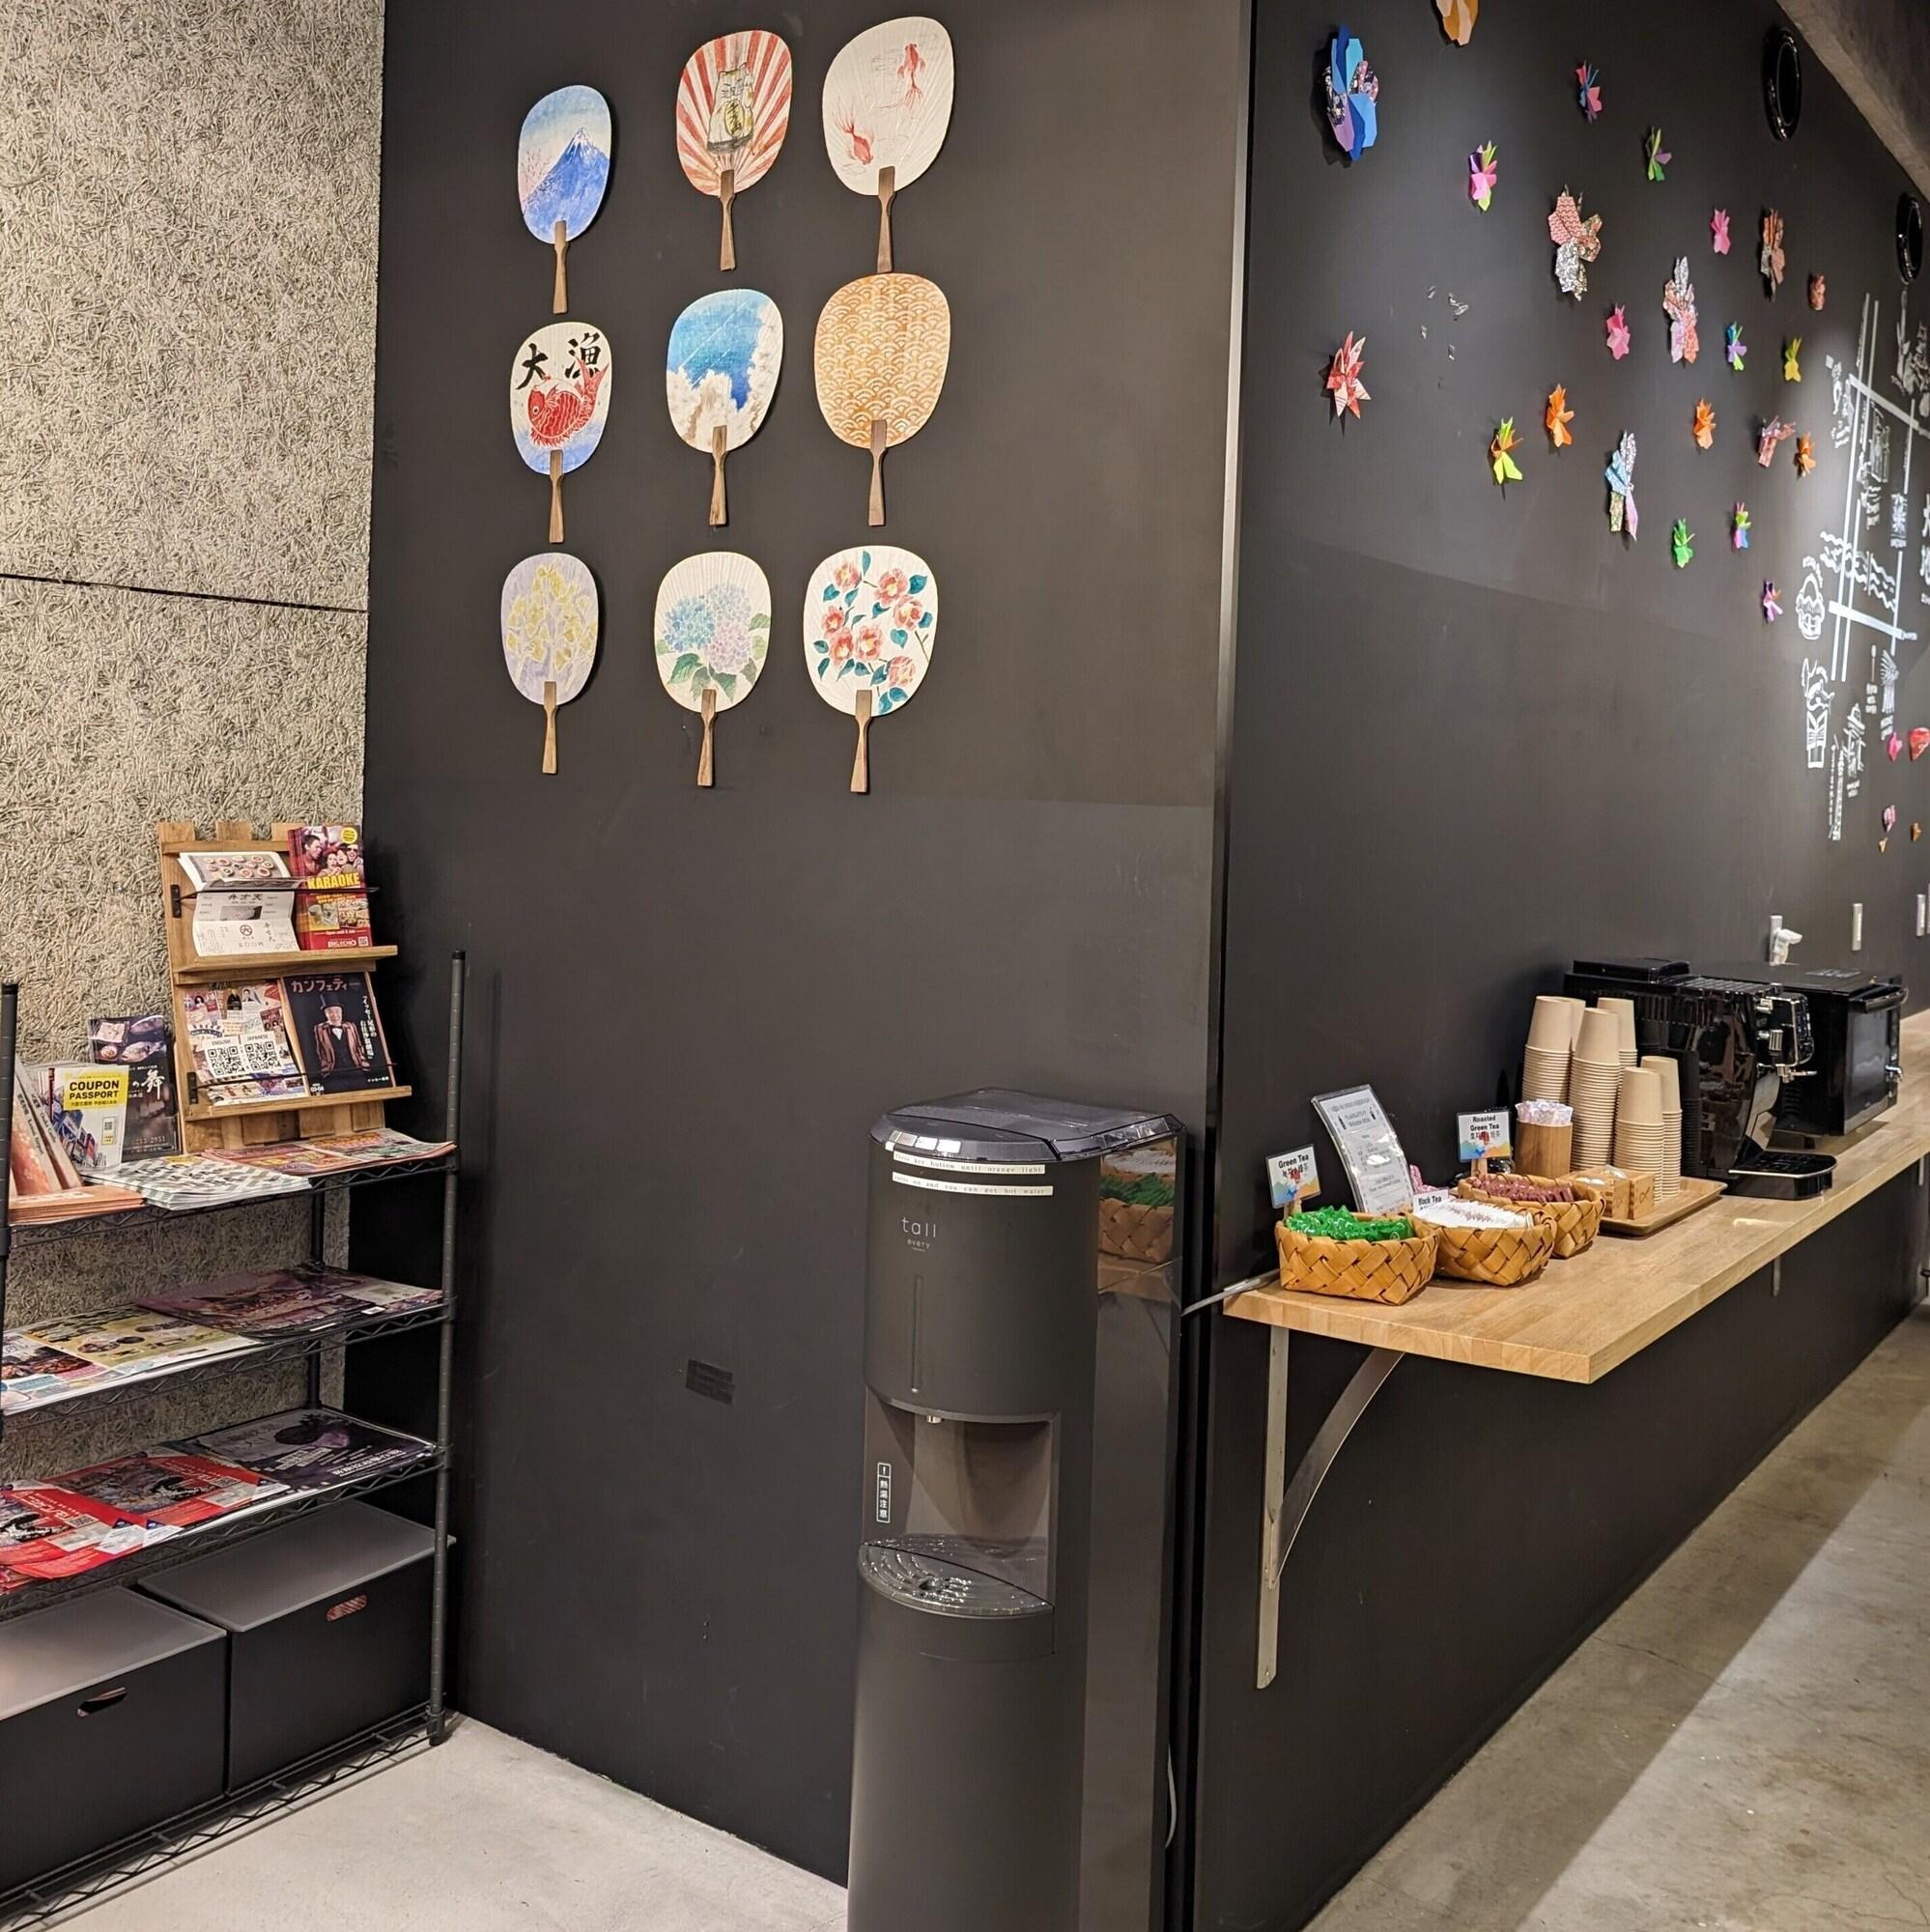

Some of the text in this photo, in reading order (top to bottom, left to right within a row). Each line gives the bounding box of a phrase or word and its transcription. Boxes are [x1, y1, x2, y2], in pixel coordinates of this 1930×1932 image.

[307, 872, 360, 889] KARAOKE
[70, 1080, 119, 1092] COUPON
[70, 1090, 119, 1100] PASSPORT
[1278, 1158, 1297, 1169] Green
[901, 1216, 936, 1237] tall
